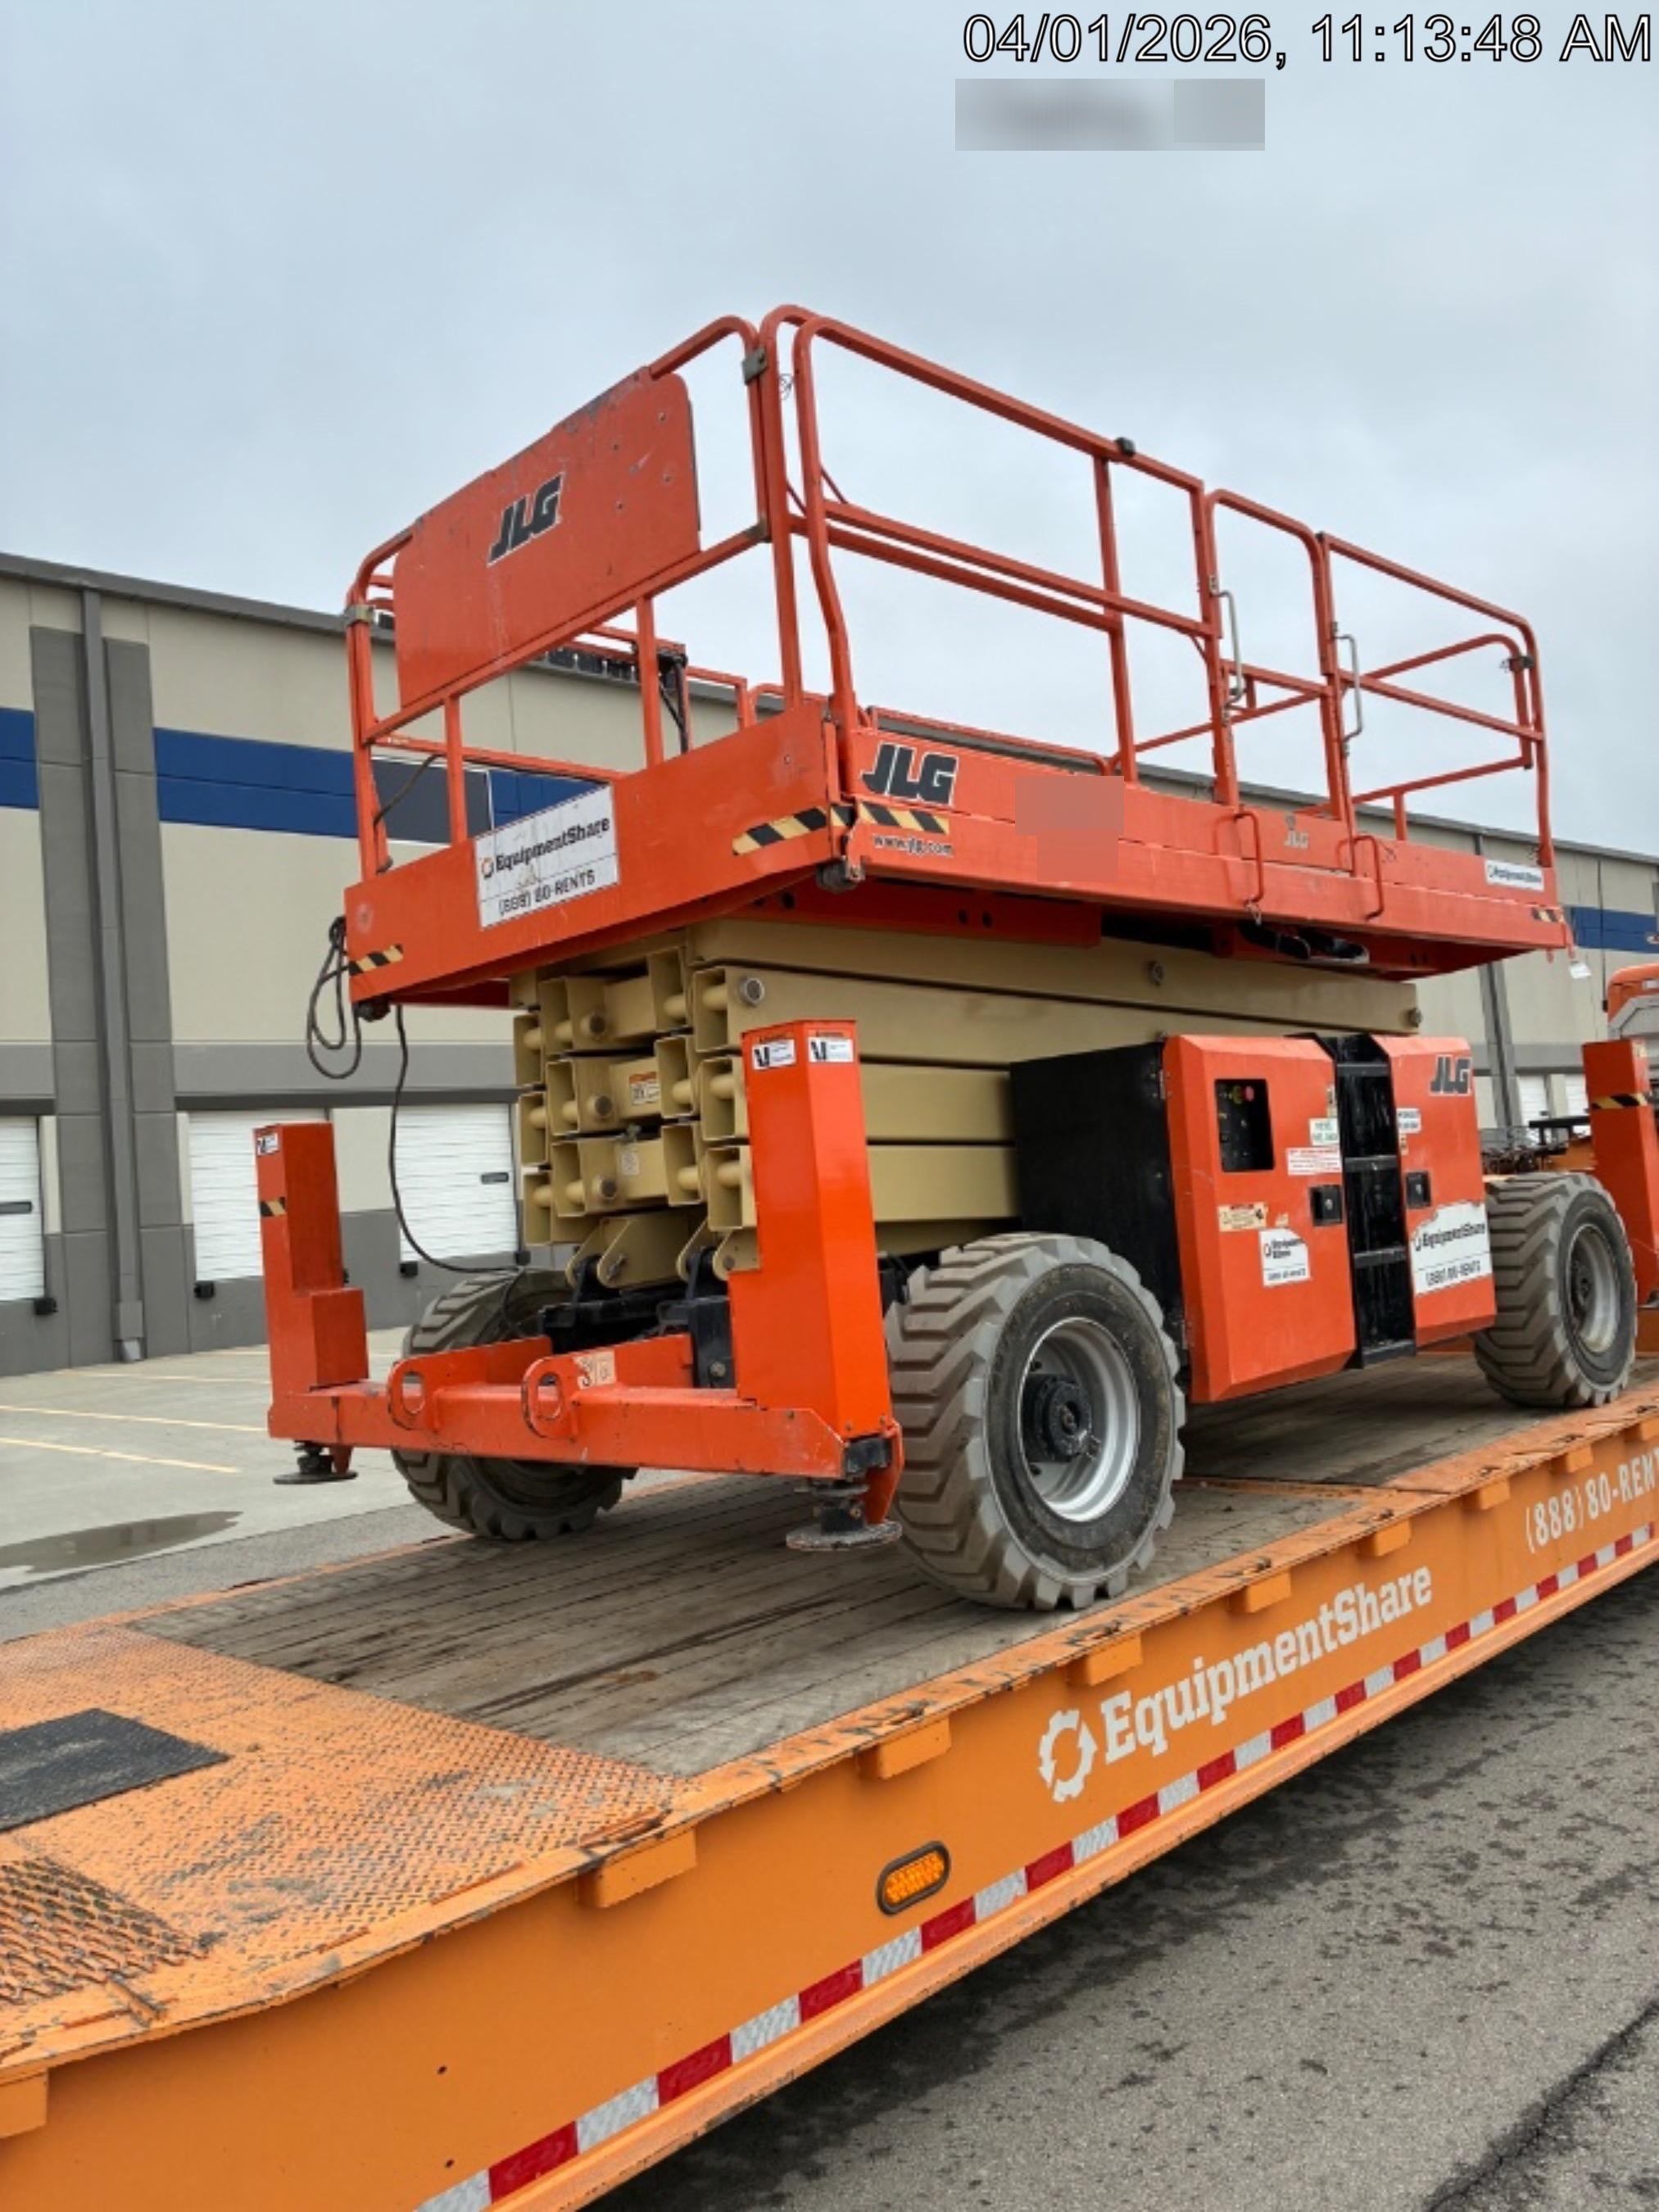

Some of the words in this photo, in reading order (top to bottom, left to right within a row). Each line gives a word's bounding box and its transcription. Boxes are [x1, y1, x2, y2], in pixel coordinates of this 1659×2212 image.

[486, 471, 564, 567] JLG
[859, 741, 959, 808] JLG
[496, 818, 610, 871] EquipmentShare
[872, 833, 954, 856] www.jlg.com
[1429, 1054, 1472, 1097] JLG
[1525, 1485, 1584, 1553] (888)
[1100, 1566, 1432, 1764] EquipmentShare
